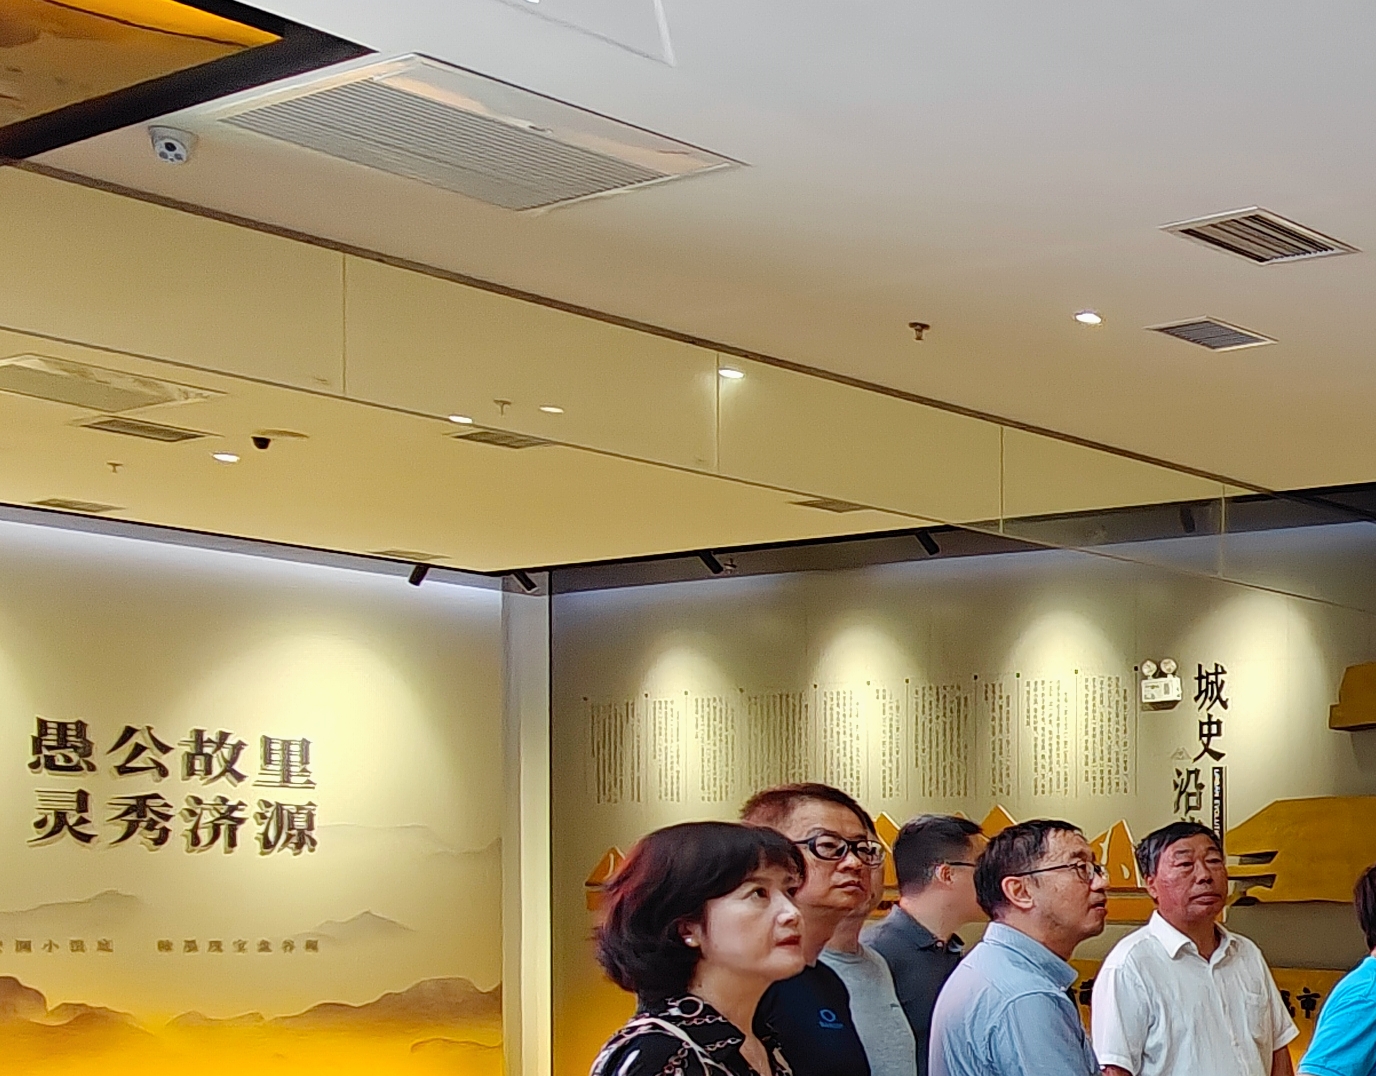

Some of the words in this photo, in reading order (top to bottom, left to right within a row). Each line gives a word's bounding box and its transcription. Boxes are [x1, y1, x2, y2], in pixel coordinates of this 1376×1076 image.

[1193, 662, 1229, 763] 城史
[27, 716, 317, 790] 愚公故里
[26, 788, 318, 856] 灵秀济源
[1172, 767, 1206, 823] 沿
